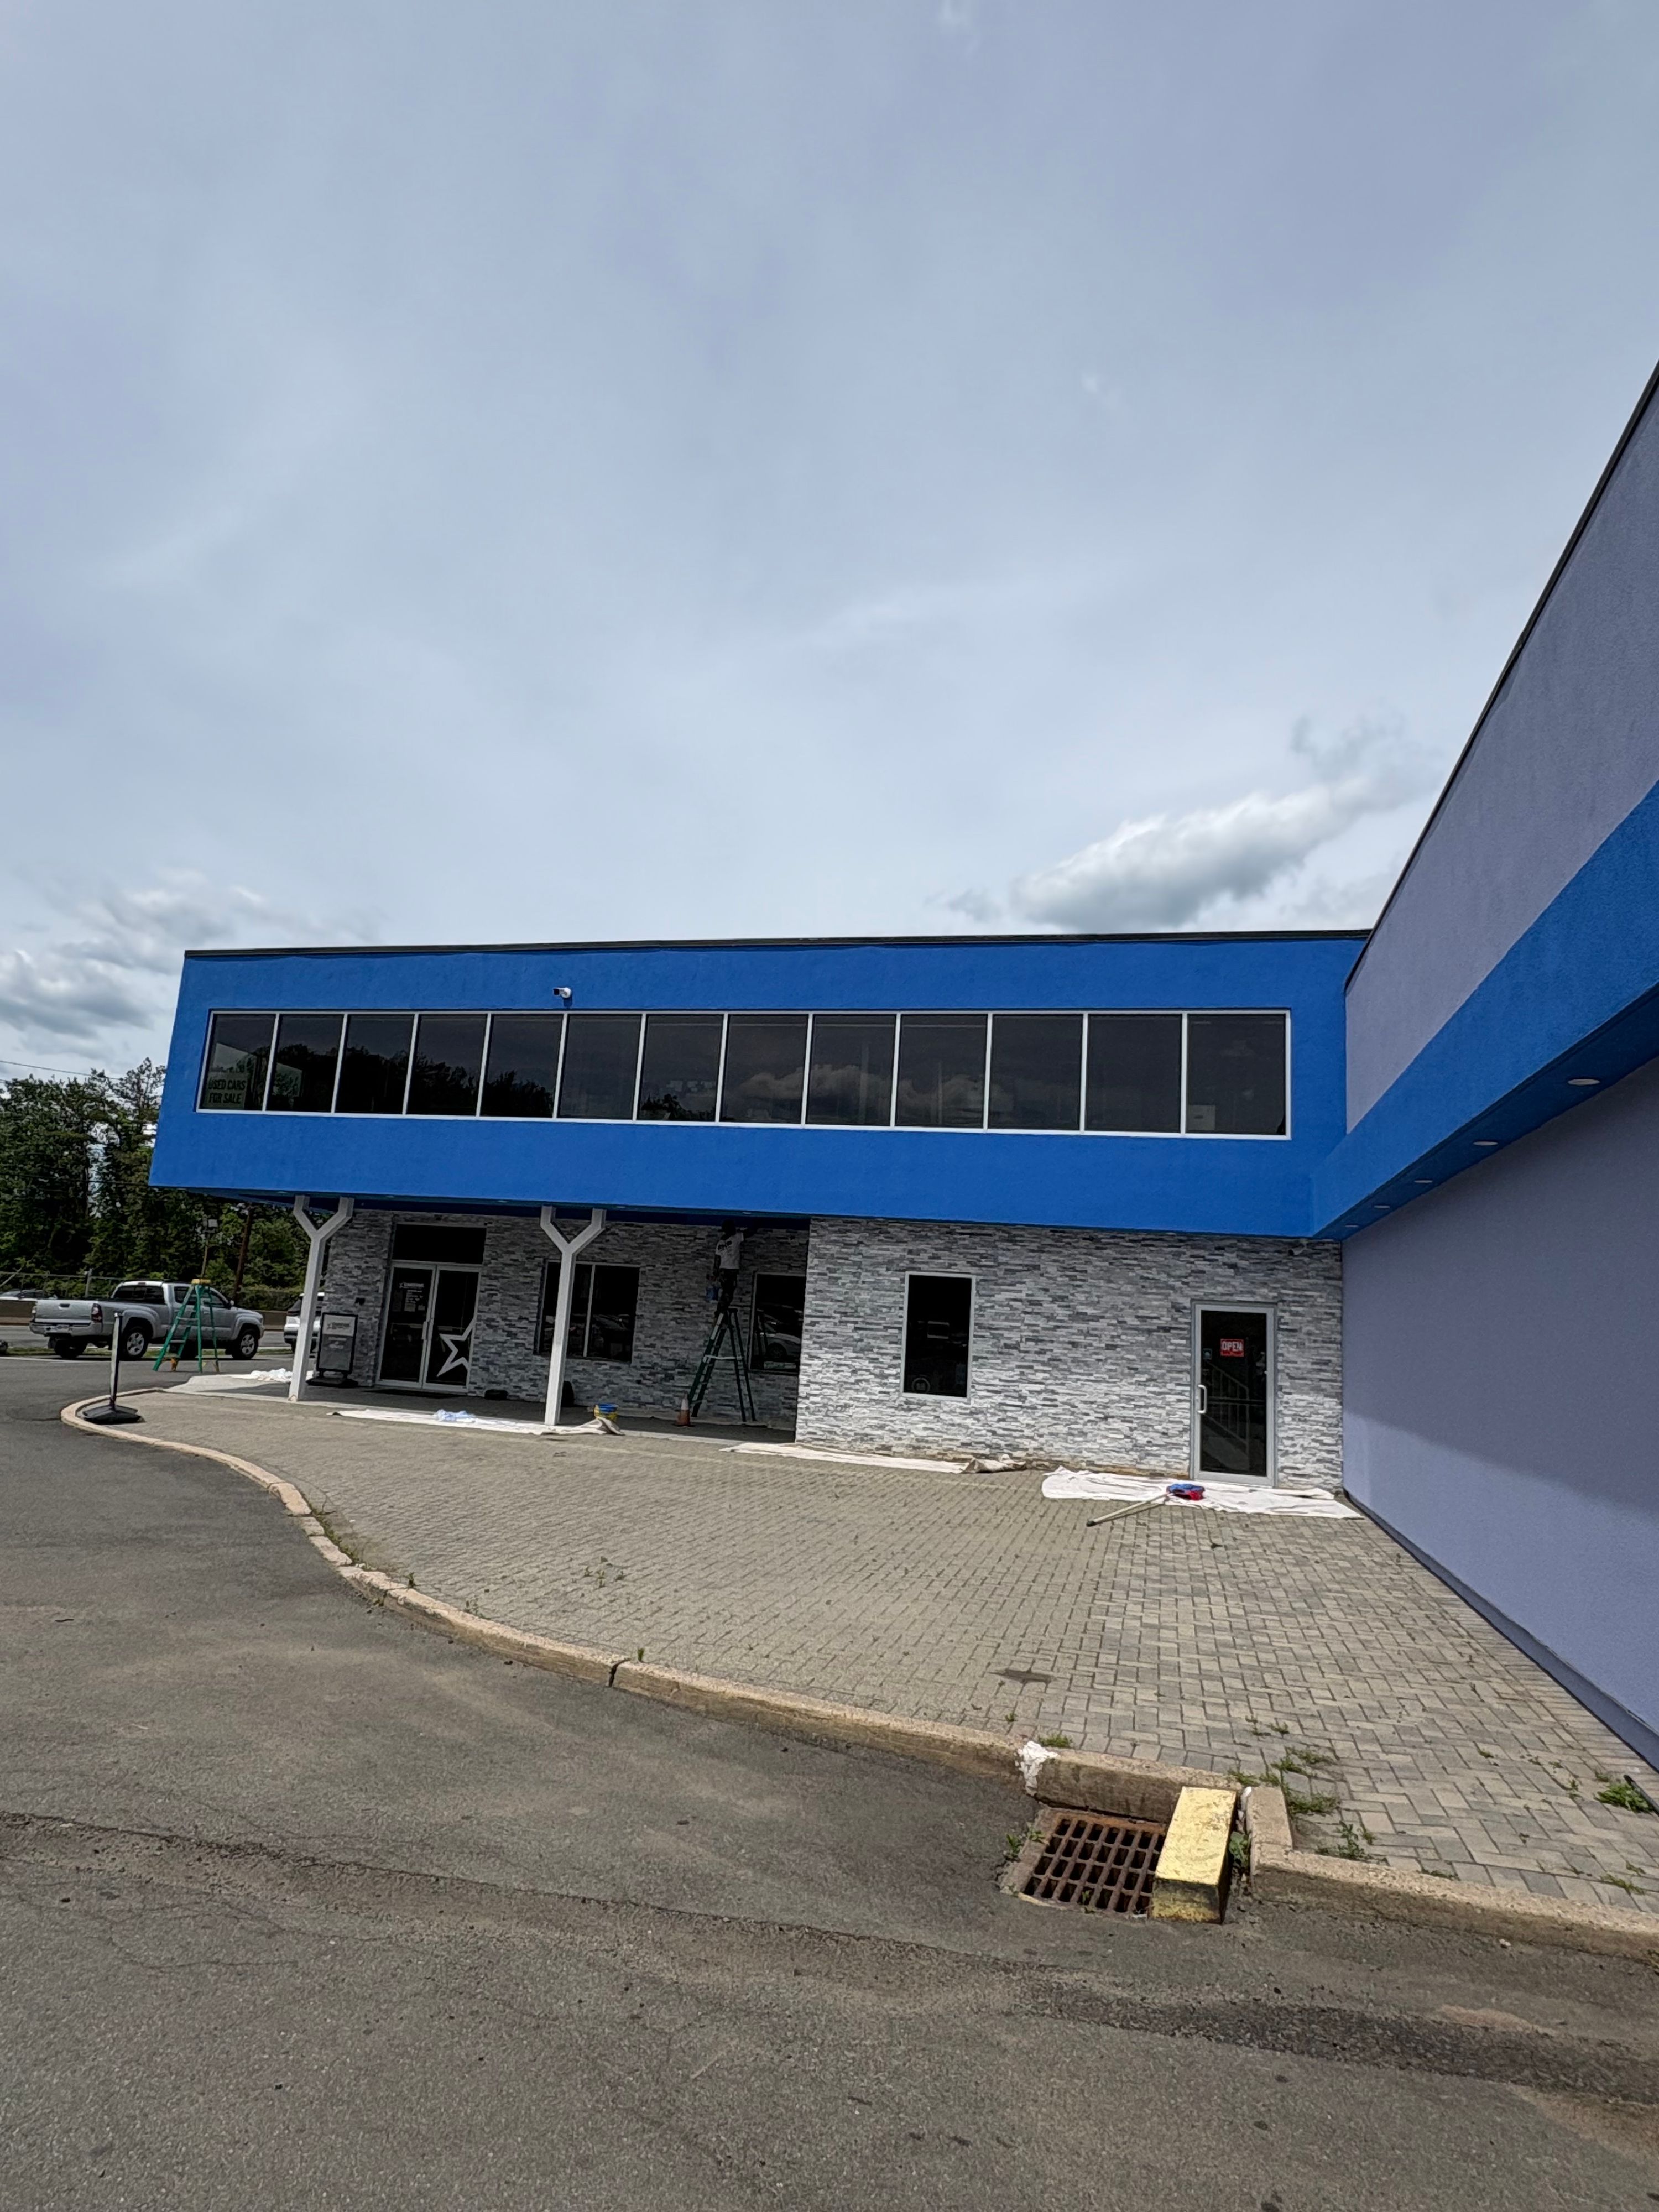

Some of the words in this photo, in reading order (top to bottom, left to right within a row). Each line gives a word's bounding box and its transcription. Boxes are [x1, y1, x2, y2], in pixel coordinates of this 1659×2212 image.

[208, 1079, 226, 1089] USED
[227, 1080, 246, 1090] CARS
[208, 1093, 222, 1103] FOR
[223, 1093, 242, 1104] SALE
[1221, 1341, 1244, 1352] OPEN
